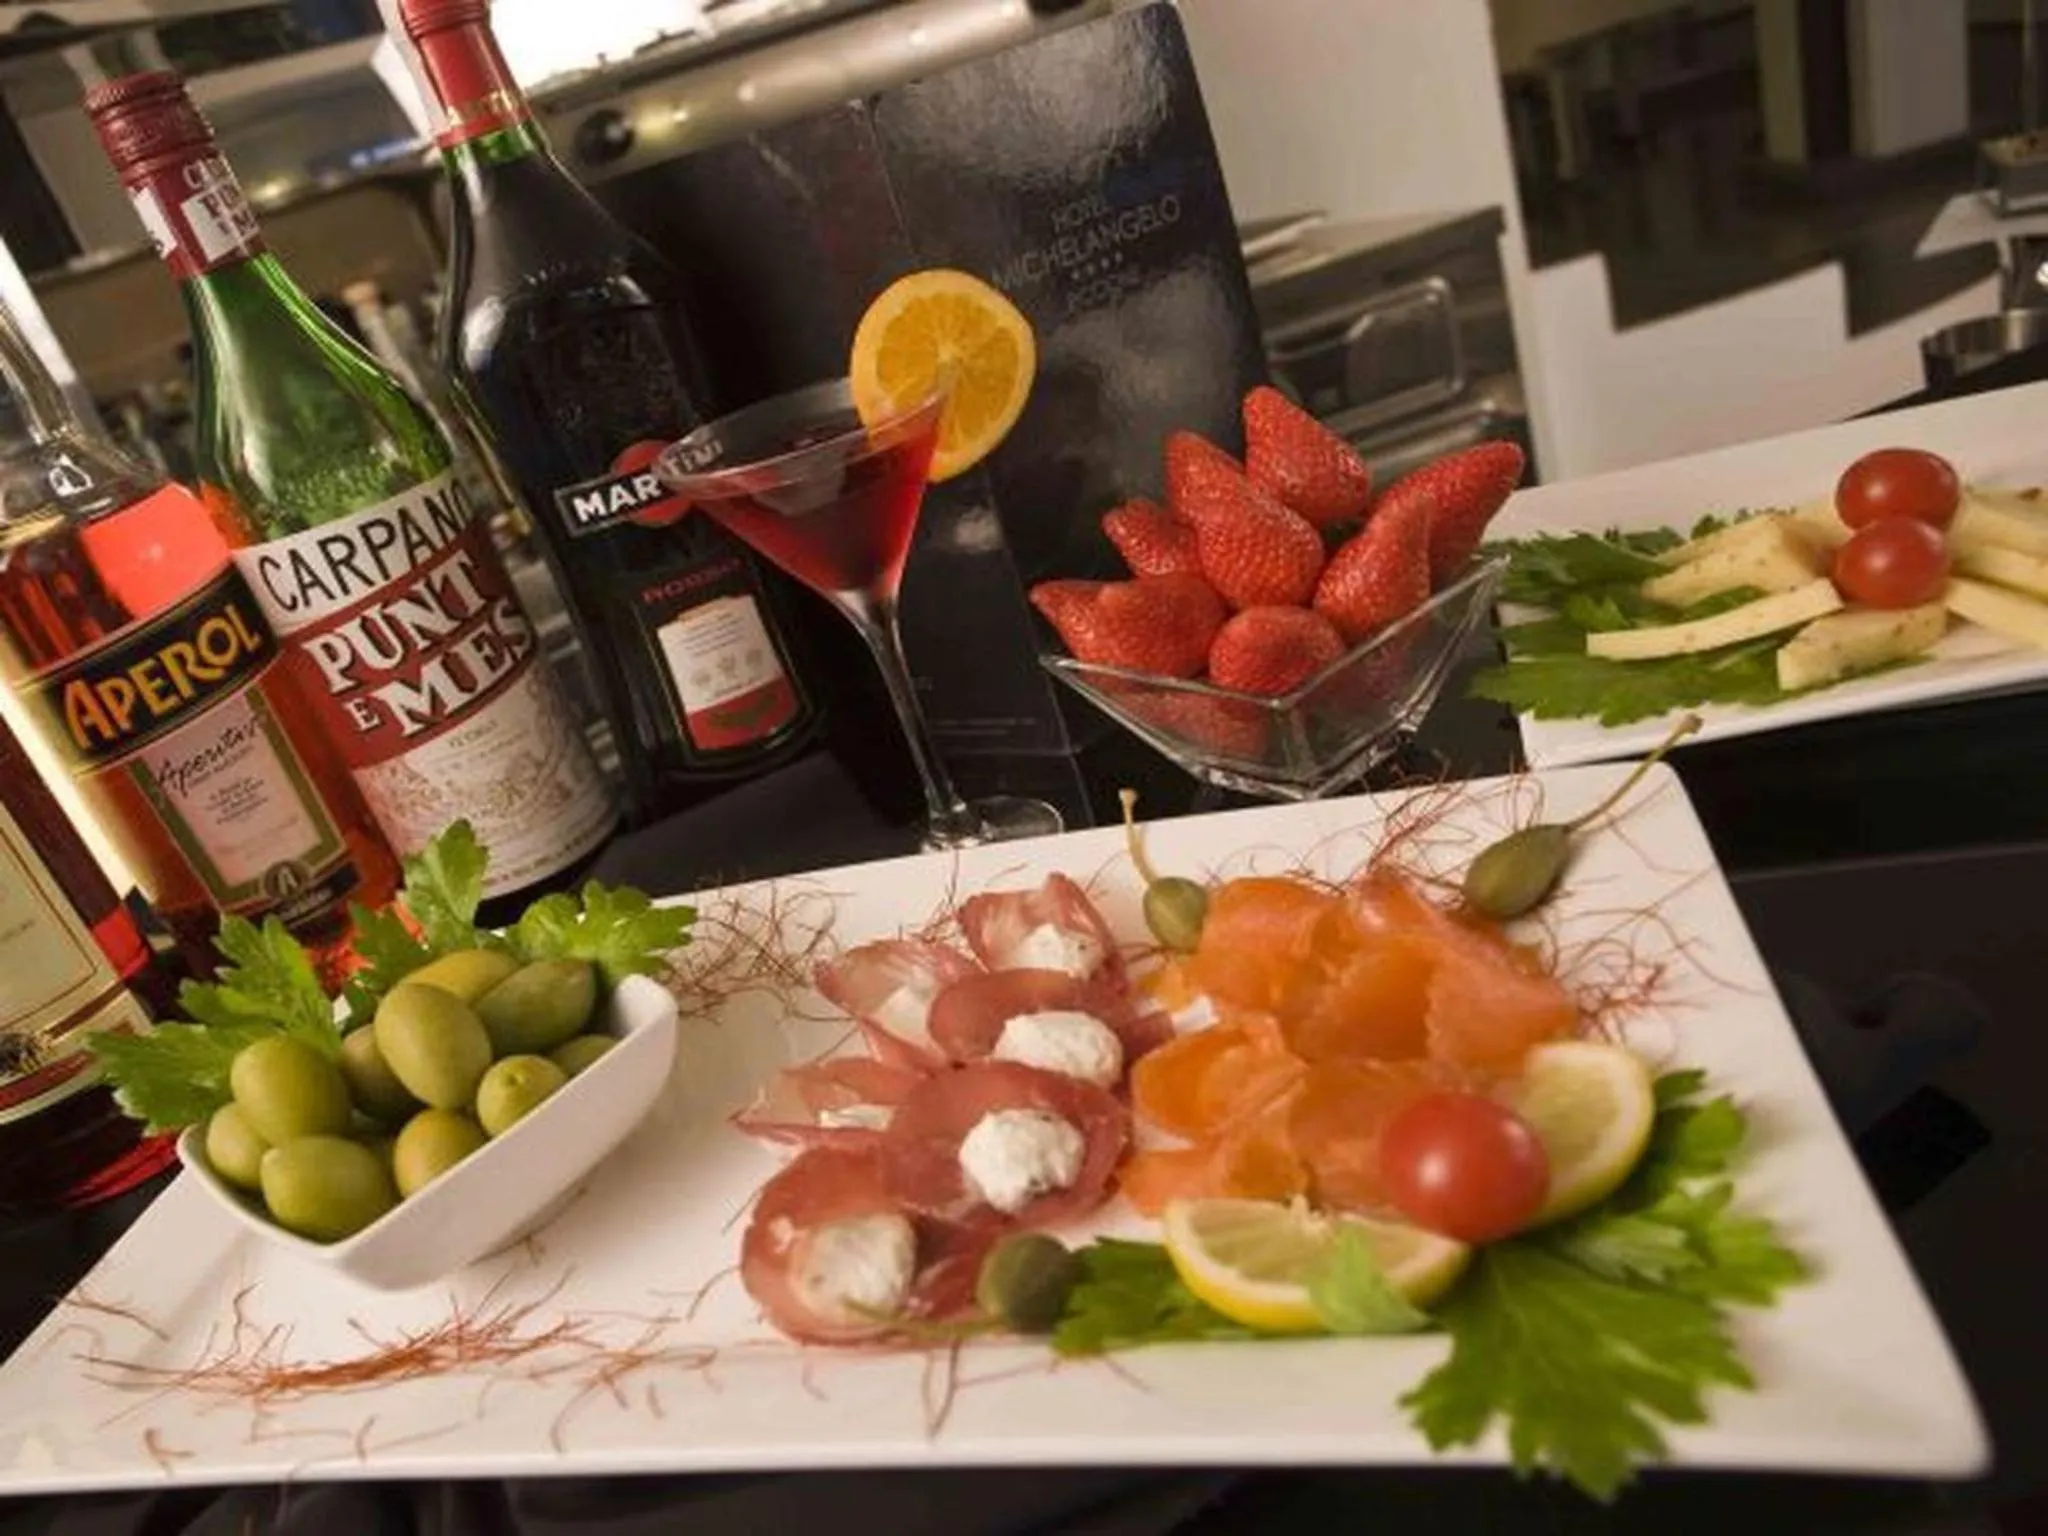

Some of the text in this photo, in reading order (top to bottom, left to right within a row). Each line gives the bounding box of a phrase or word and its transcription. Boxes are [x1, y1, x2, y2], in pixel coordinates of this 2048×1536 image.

[64, 604, 263, 749] APEROL
[303, 549, 488, 694] PUNT
[345, 697, 381, 732] E
